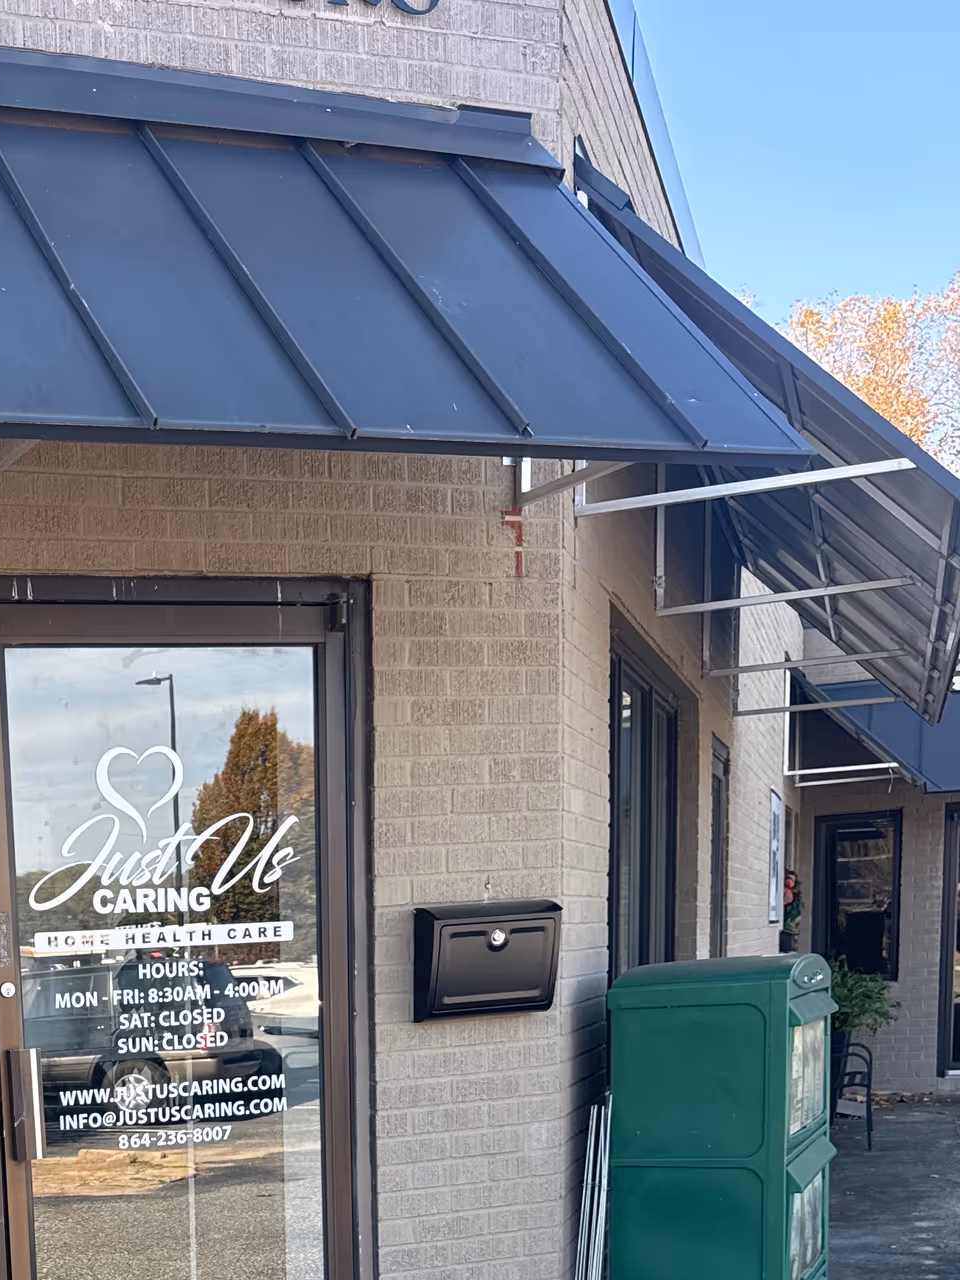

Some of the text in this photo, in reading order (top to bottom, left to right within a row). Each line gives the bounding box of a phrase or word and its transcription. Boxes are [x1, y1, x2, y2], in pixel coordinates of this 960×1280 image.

[29, 812, 301, 911] Just Us
[93, 886, 212, 914] CARING
[47, 926, 283, 949] HOME HEALTH CARE
[138, 960, 204, 979] HOURS:
[55, 992, 98, 1009] MON
[113, 988, 145, 1006] FRI:
[147, 984, 211, 1003] 8:30AM
[224, 979, 284, 998] 4:00PM
[119, 1007, 225, 1029] SAT: CLOSED
[118, 1031, 228, 1054] SUN: CLOSED
[60, 1074, 286, 1107] WWW.JUSTUSCARING.COM
[60, 1097, 288, 1130] INFO@JUSTUSCARING.COM
[118, 1125, 232, 1149] 864-236-8007
